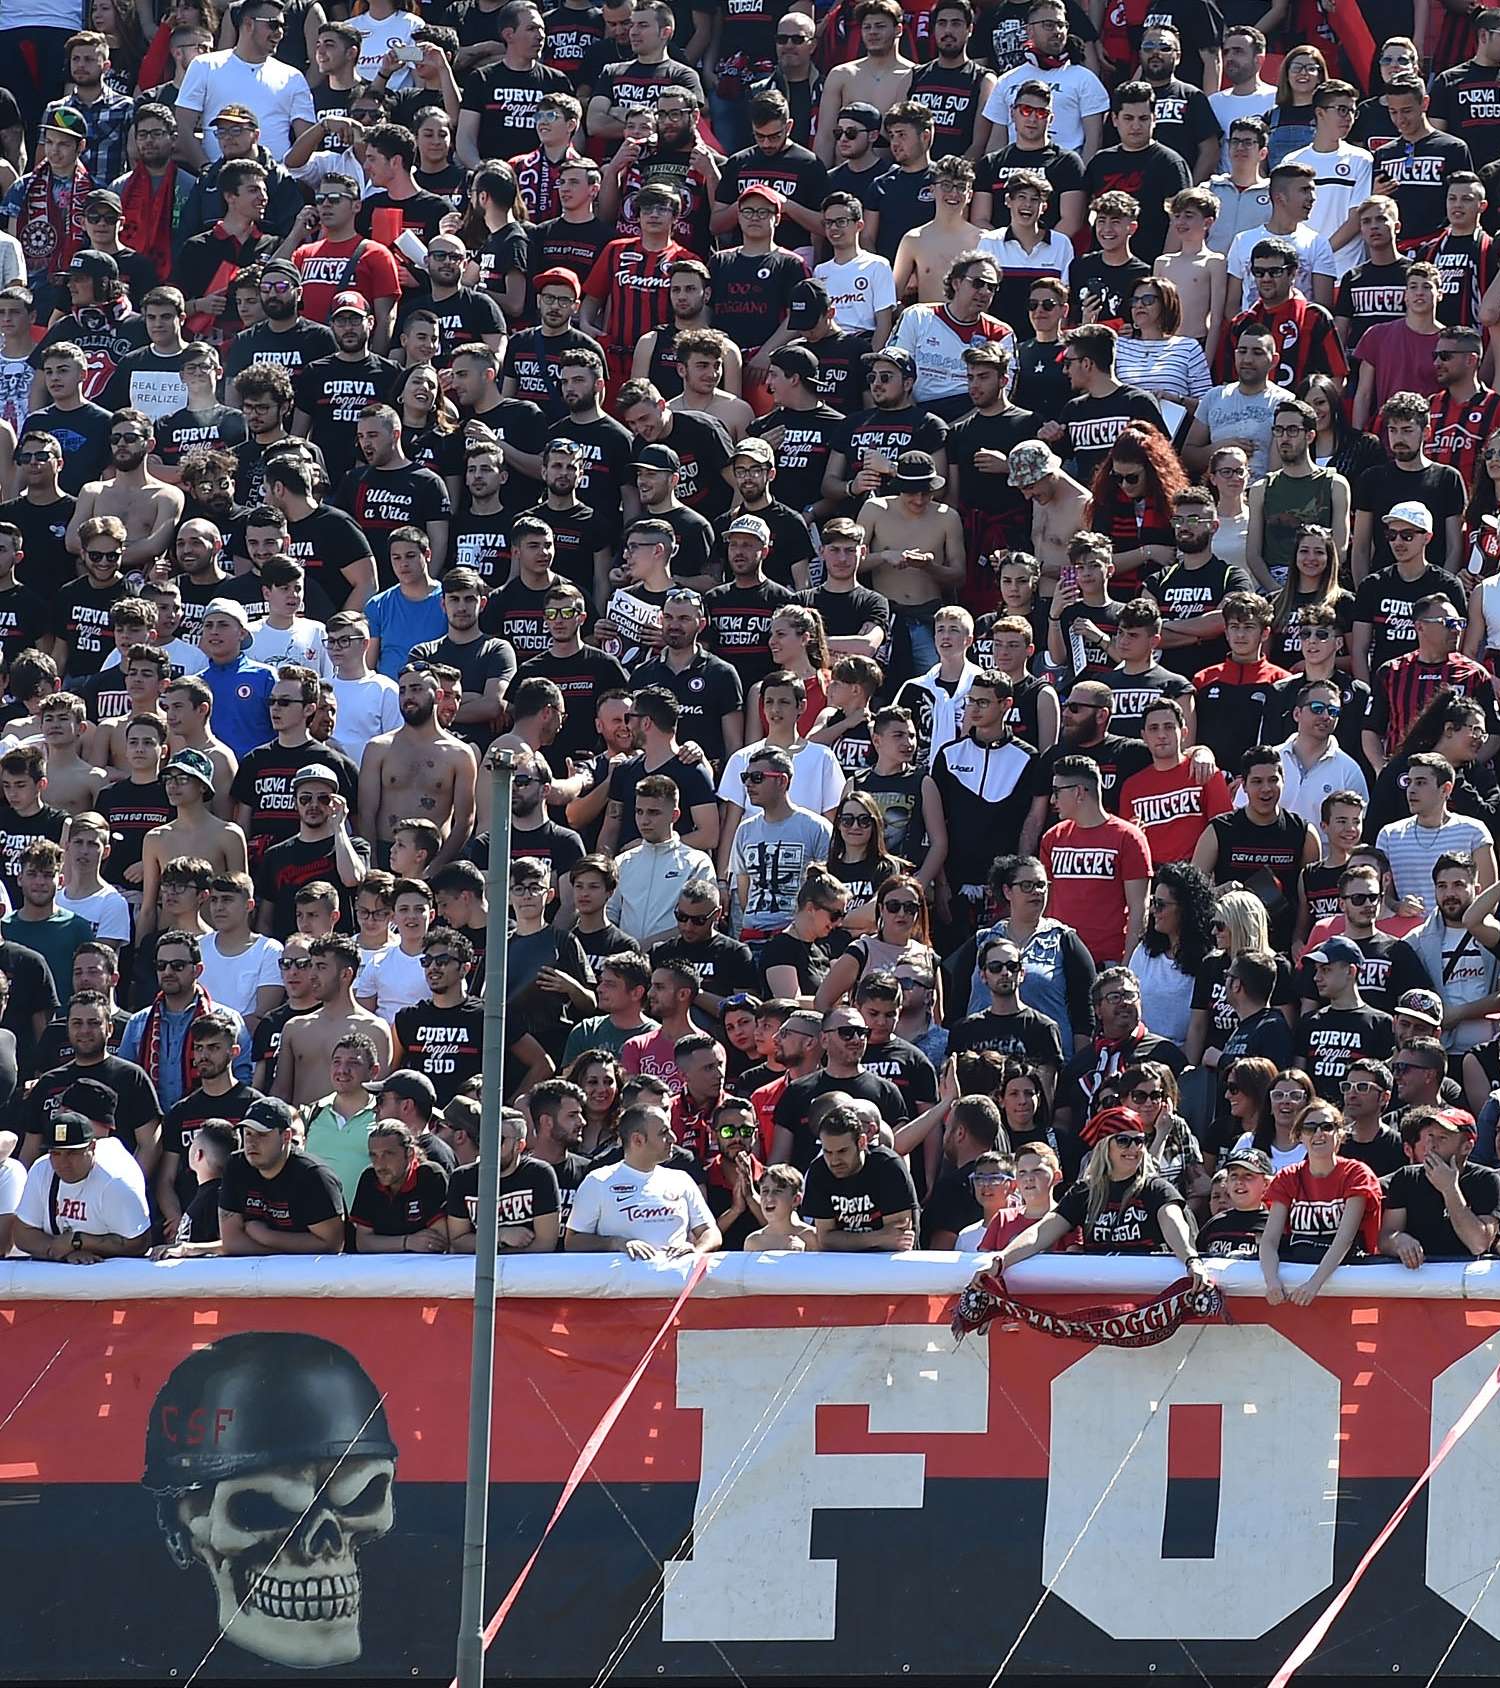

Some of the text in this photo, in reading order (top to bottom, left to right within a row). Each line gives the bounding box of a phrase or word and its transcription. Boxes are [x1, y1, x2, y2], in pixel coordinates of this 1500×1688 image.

[494, 88, 544, 102] CURVA
[1458, 89, 1495, 104] CURVA
[772, 180, 796, 196] SUD
[827, 291, 866, 304] mma
[253, 351, 302, 365] CURVA
[132, 380, 161, 392] REAL
[323, 380, 376, 396] CURVA
[136, 392, 180, 404] REALIZE
[172, 426, 220, 440] CURVA
[850, 432, 912, 448] CURVA SUD
[778, 455, 808, 468] SUD
[365, 489, 413, 506] Ultras
[364, 505, 410, 522] a Vita
[1165, 587, 1212, 601] CURVA
[719, 630, 759, 645] FOGGIA
[416, 1026, 469, 1043] CURVA
[1310, 1030, 1361, 1048] CURVA
[421, 1040, 459, 1055] Foggia
[1315, 1045, 1351, 1060] Foggia
[424, 1058, 455, 1074] SUD
[1313, 1061, 1346, 1077] SUD
[158, 1404, 237, 1450] CSF
